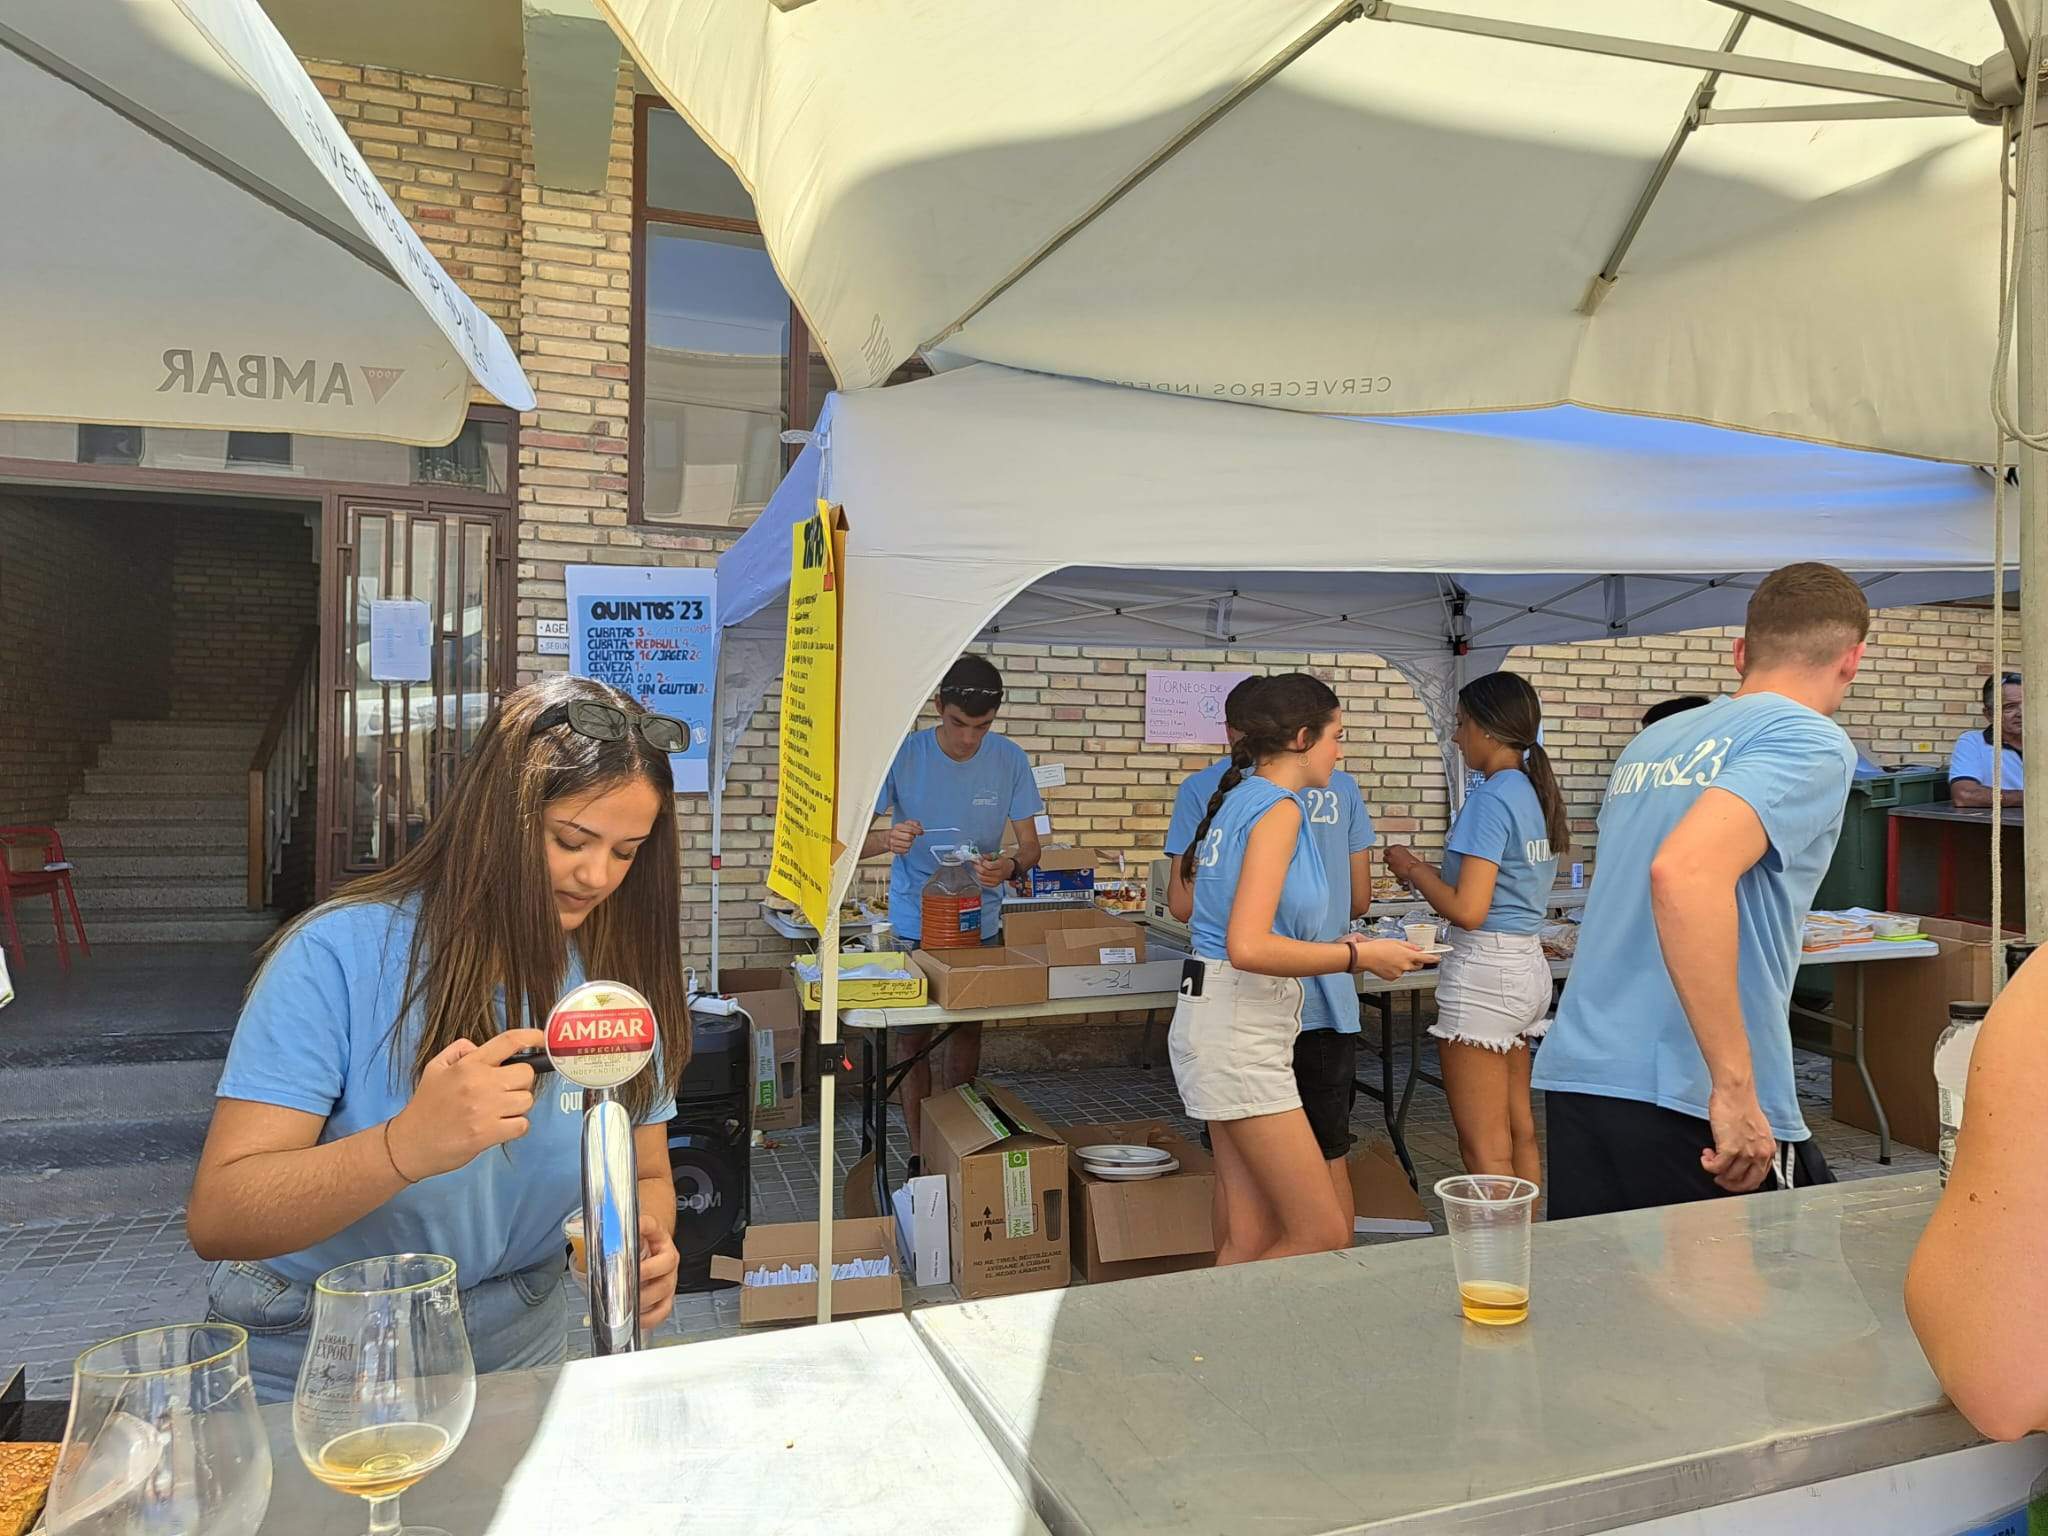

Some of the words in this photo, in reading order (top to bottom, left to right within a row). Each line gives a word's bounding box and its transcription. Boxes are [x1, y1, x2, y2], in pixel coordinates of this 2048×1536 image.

[545, 623, 568, 634] AGE
[587, 627, 635, 638] CUBATAS
[589, 662, 632, 673] CERVEZA
[637, 684, 655, 695] SIN
[659, 683, 699, 695] GLUTEN
[1151, 676, 1207, 694] TORNEOS
[557, 1018, 649, 1042] AMBAR
[576, 1045, 627, 1055] ESPECIAL
[316, 1340, 357, 1361] EXPORT
